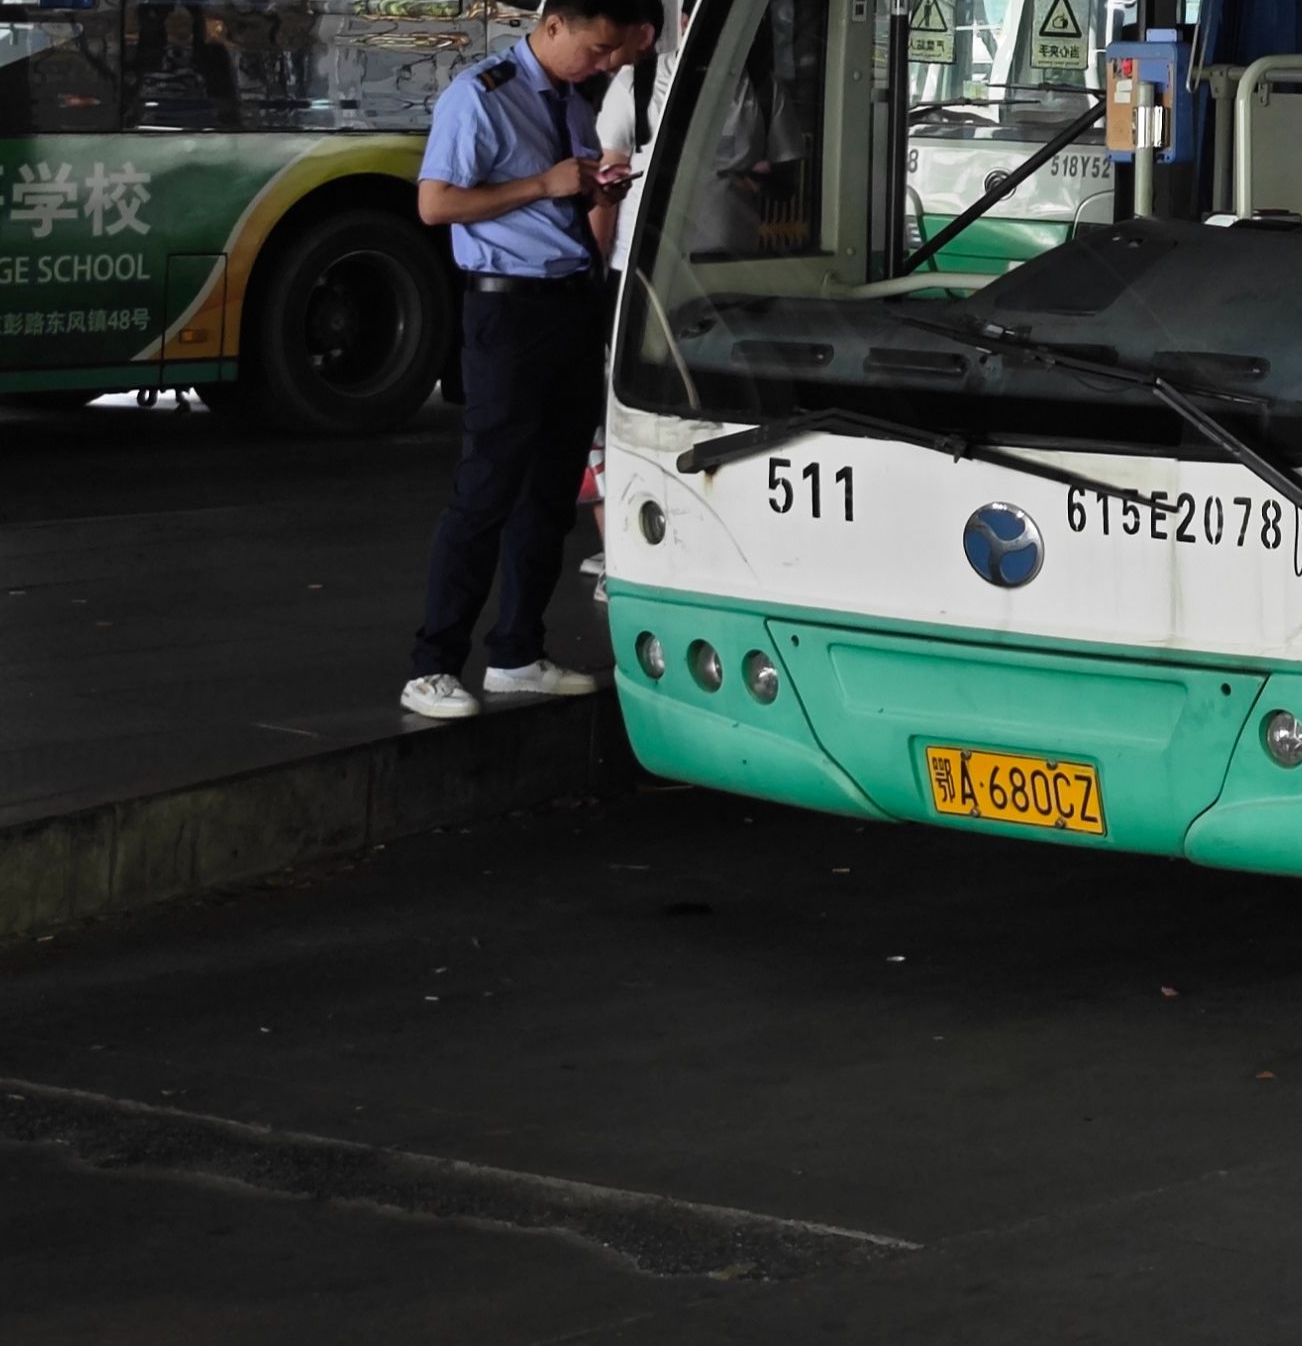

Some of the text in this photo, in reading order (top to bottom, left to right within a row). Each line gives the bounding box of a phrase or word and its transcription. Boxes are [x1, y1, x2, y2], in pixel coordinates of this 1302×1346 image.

[0, 161, 151, 238] 学校
[37, 253, 151, 283] SCHOOL
[0, 308, 150, 335] 彭路东风镇48号
[768, 457, 854, 522] 511
[1067, 485, 1283, 550] 615E2078
